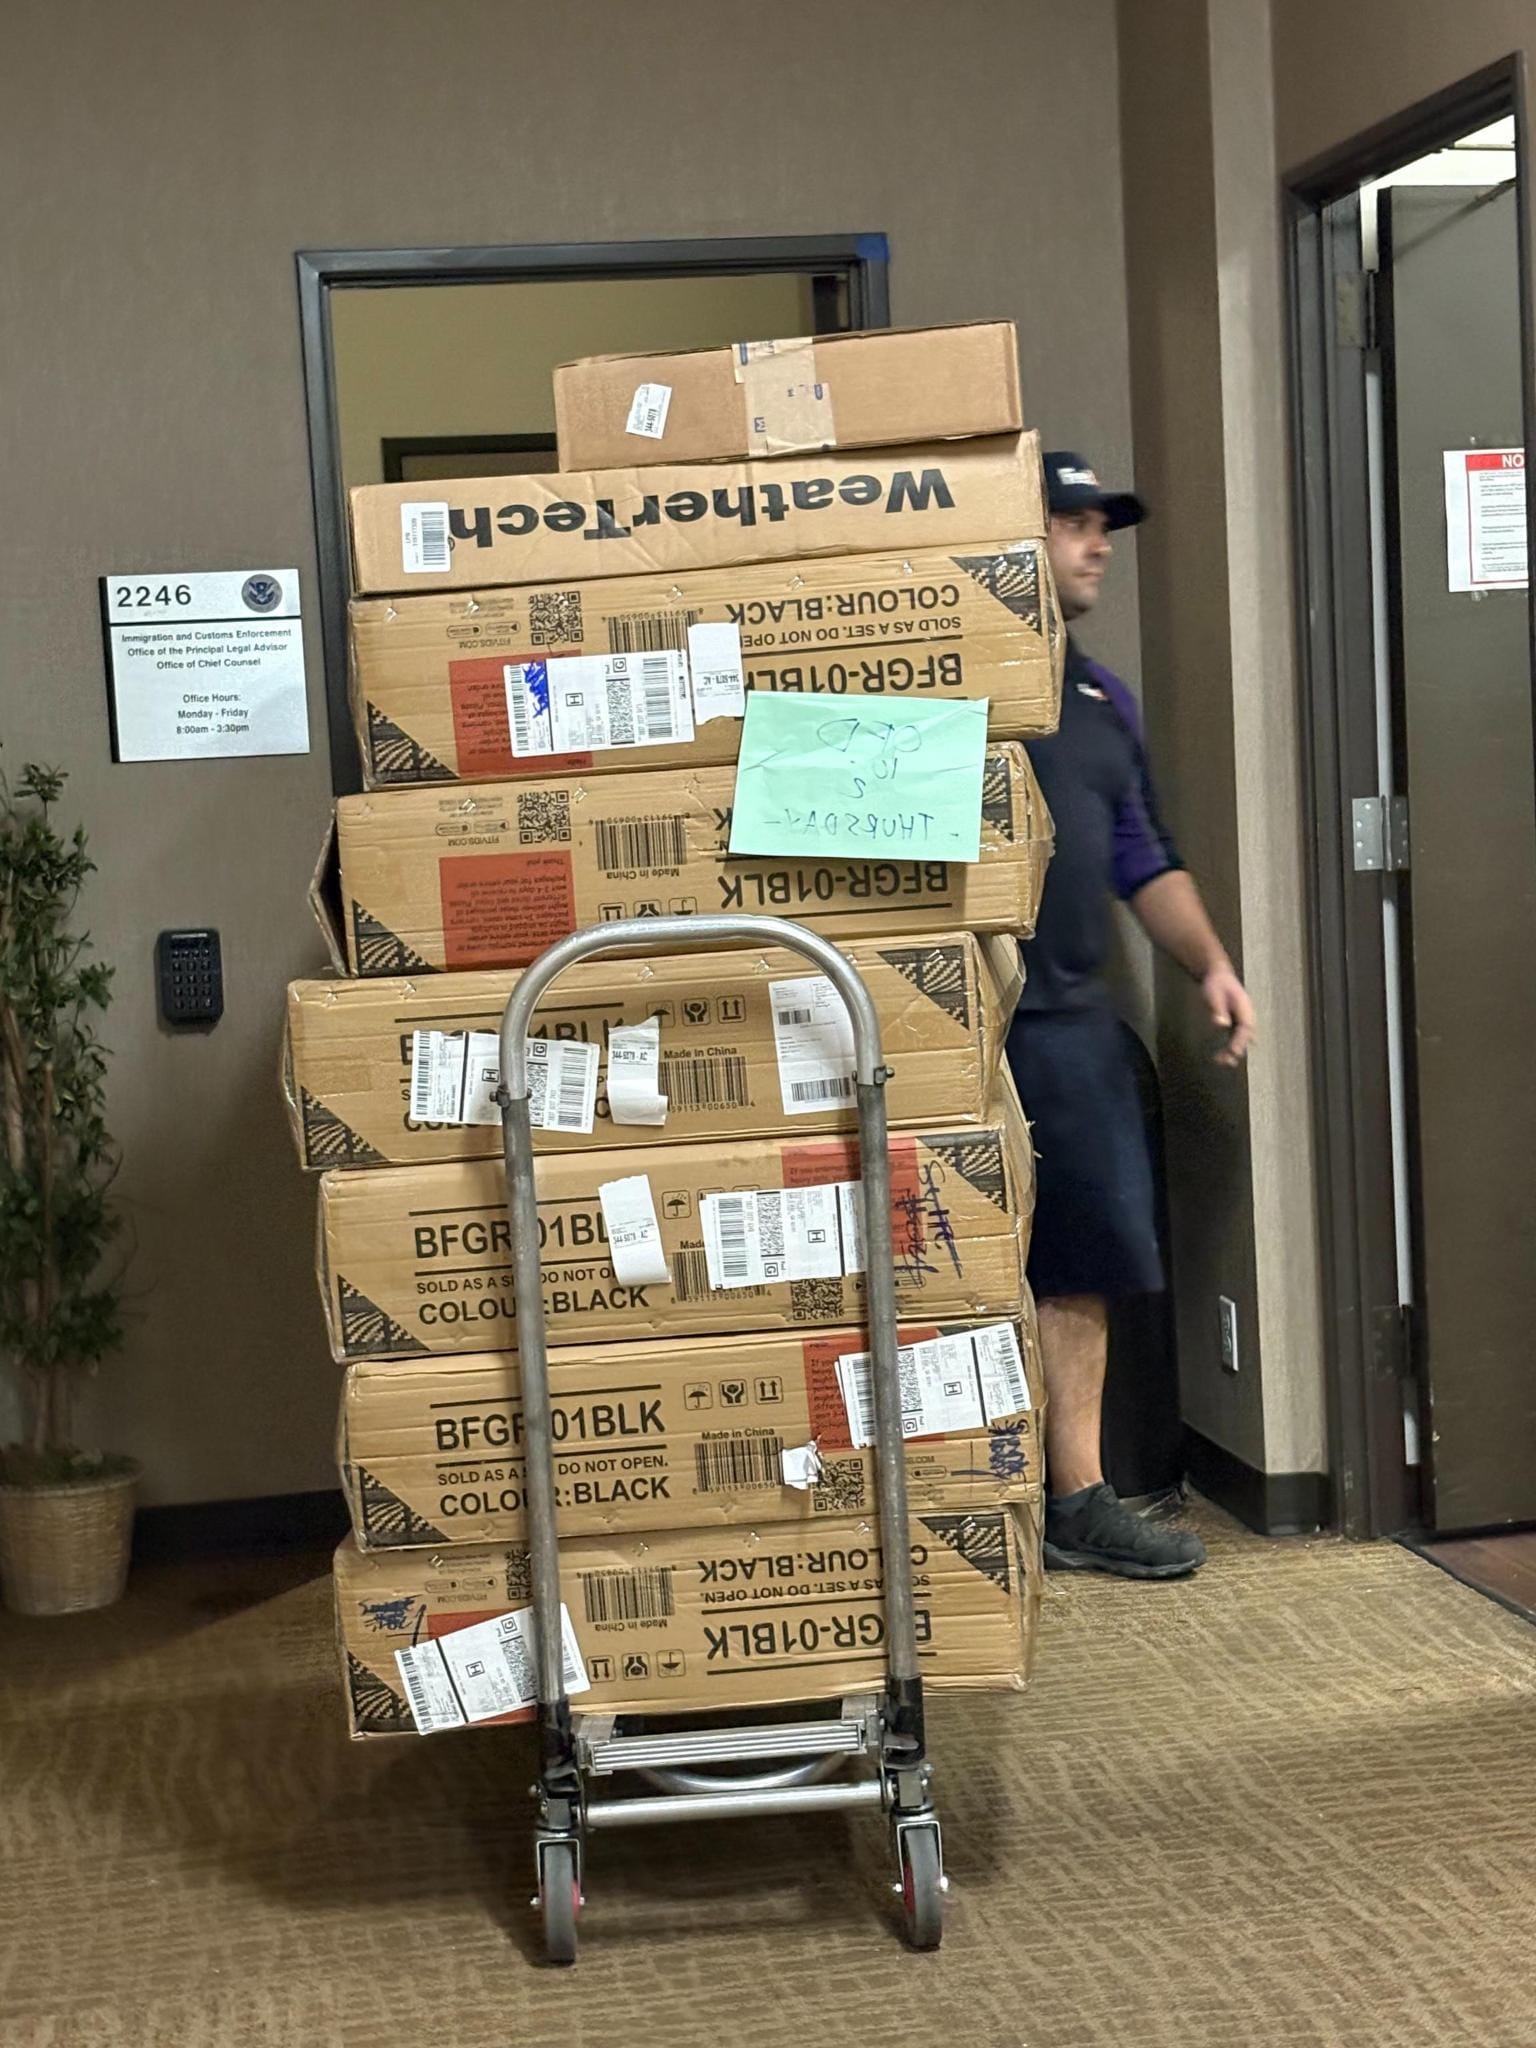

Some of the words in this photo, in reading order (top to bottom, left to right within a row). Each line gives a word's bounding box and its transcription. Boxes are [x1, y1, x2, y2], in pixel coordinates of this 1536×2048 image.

[449, 468, 956, 549] WeatherTech
[116, 584, 193, 608] 2246
[724, 584, 960, 625] COLOUR:BLACK
[842, 624, 875, 639] SET.
[878, 622, 890, 635] A
[893, 620, 914, 635] AS
[918, 616, 961, 632] SOLD
[121, 633, 174, 645] Immigration
[176, 632, 192, 641] and
[194, 630, 233, 640] Customs
[236, 628, 292, 638] Enforcement
[739, 633, 776, 648] OPE
[778, 630, 812, 646] NOT
[815, 627, 839, 642] DO
[127, 647, 155, 657] Office
[157, 646, 167, 655] of
[168, 646, 184, 655] the
[186, 645, 224, 656] Principal
[226, 643, 251, 655] Legal
[253, 642, 288, 652] Advisor
[156, 660, 184, 669] Office
[186, 659, 196, 668] of
[198, 659, 222, 668] Chief
[224, 658, 261, 667] Counsel
[743, 653, 962, 694] BFGR-01BL
[182, 693, 210, 703] Office
[211, 693, 241, 702] Hours:
[177, 709, 214, 721] Monday
[221, 708, 249, 719] Friday
[176, 725, 209, 735] 8:00am
[216, 724, 250, 735] 3:30pm
[605, 870, 637, 880] China
[639, 869, 649, 878] in
[651, 867, 681, 877] Made
[716, 860, 950, 909] BFGR-01BLK
[663, 1048, 694, 1059] Made
[695, 1048, 705, 1057] in
[706, 1045, 737, 1056] China
[413, 1211, 611, 1259] BFGR01BL
[563, 1269, 595, 1282] NOT
[417, 1279, 459, 1295] SOLD
[463, 1277, 484, 1291] AS
[487, 1276, 498, 1289] A
[418, 1285, 650, 1326] COLOU:BLACK
[435, 1399, 666, 1451] BFG01BLK
[701, 1431, 729, 1440] Made
[731, 1430, 742, 1438] in
[744, 1427, 775, 1437] China
[558, 1461, 581, 1475] DO
[584, 1459, 618, 1473] NOT
[620, 1454, 668, 1470] OPEN.
[437, 1470, 480, 1486] SOLD
[484, 1468, 505, 1482] AS
[508, 1467, 519, 1480] A
[697, 1544, 929, 1583] CLOUR:BLACK
[788, 1583, 811, 1597] DO
[812, 1581, 846, 1596] SET.
[846, 1581, 859, 1593] A
[863, 1578, 884, 1592] AS
[699, 1588, 748, 1604] OPEN.
[752, 1586, 786, 1600] NOT
[594, 1622, 625, 1632] China
[627, 1621, 637, 1630] in
[640, 1619, 667, 1629] Made
[703, 1609, 932, 1661] BGR-01BLK
